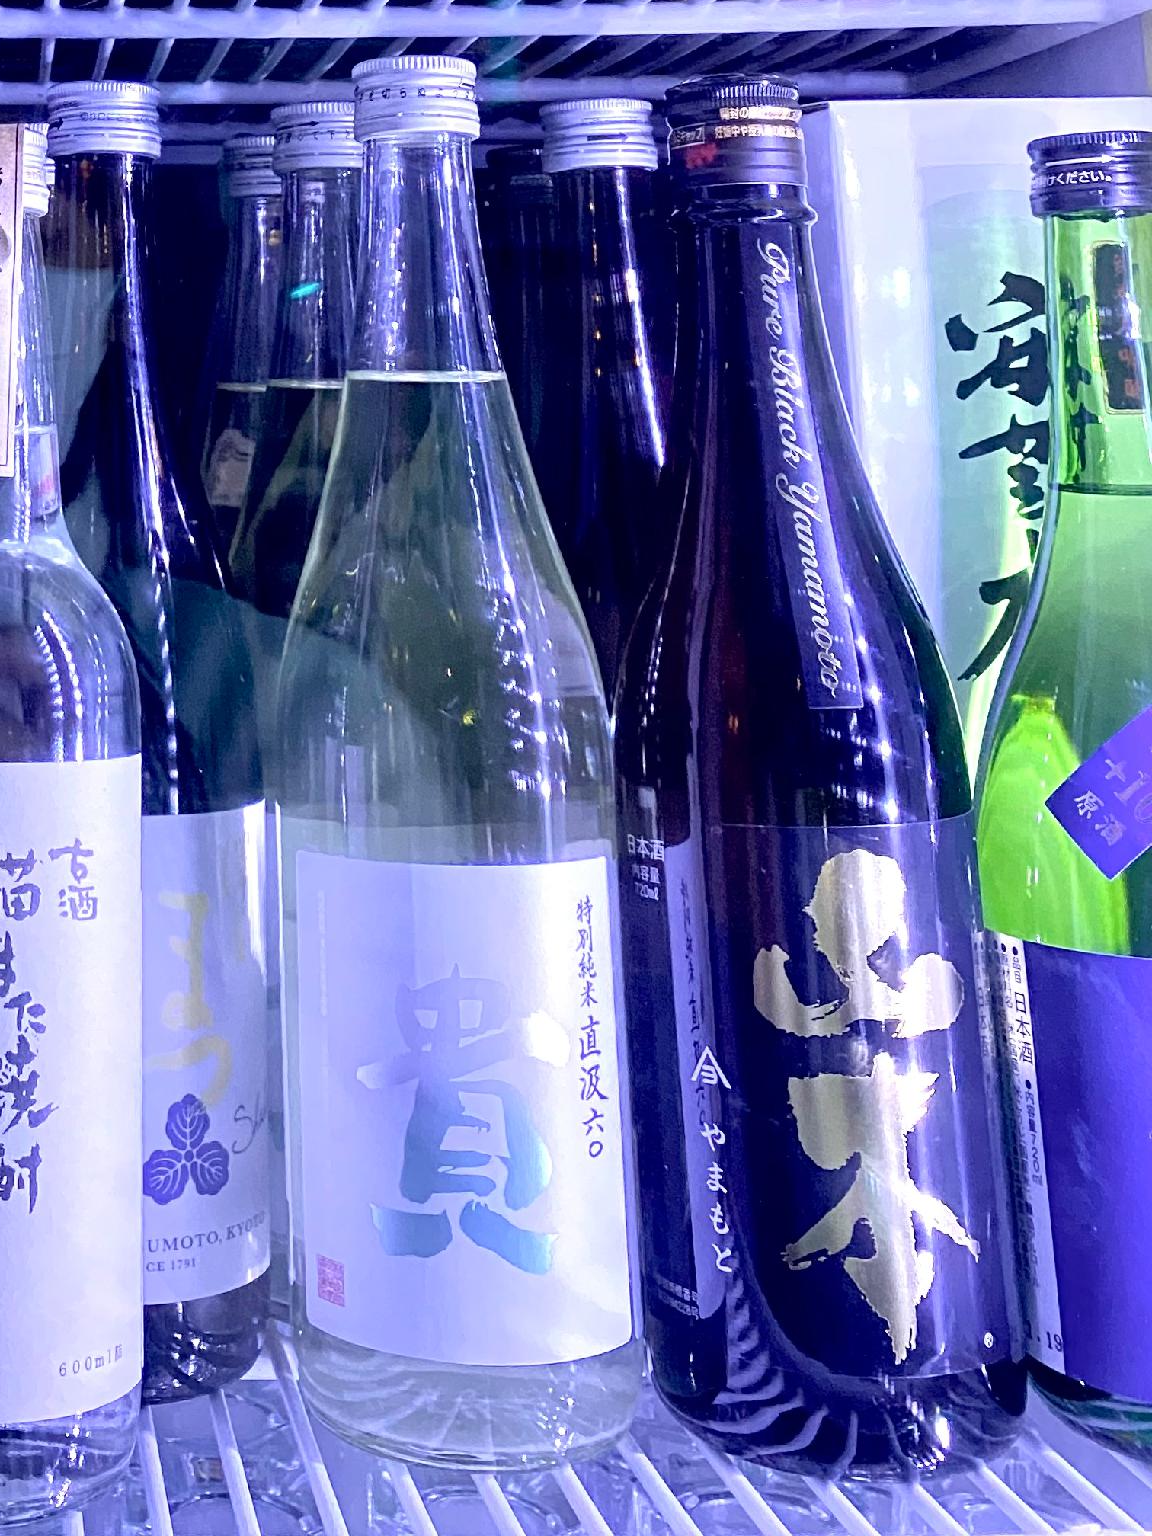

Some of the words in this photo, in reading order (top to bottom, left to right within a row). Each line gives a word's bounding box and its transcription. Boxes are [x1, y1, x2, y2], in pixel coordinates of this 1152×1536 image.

[755, 241, 792, 348] Pure
[769, 347, 812, 474] Black
[777, 473, 843, 700] Yamamoto
[48, 837, 99, 921] 古酒
[626, 834, 665, 862] 日本酒
[356, 963, 559, 1276] 貴
[698, 1122, 734, 1274] やまもと
